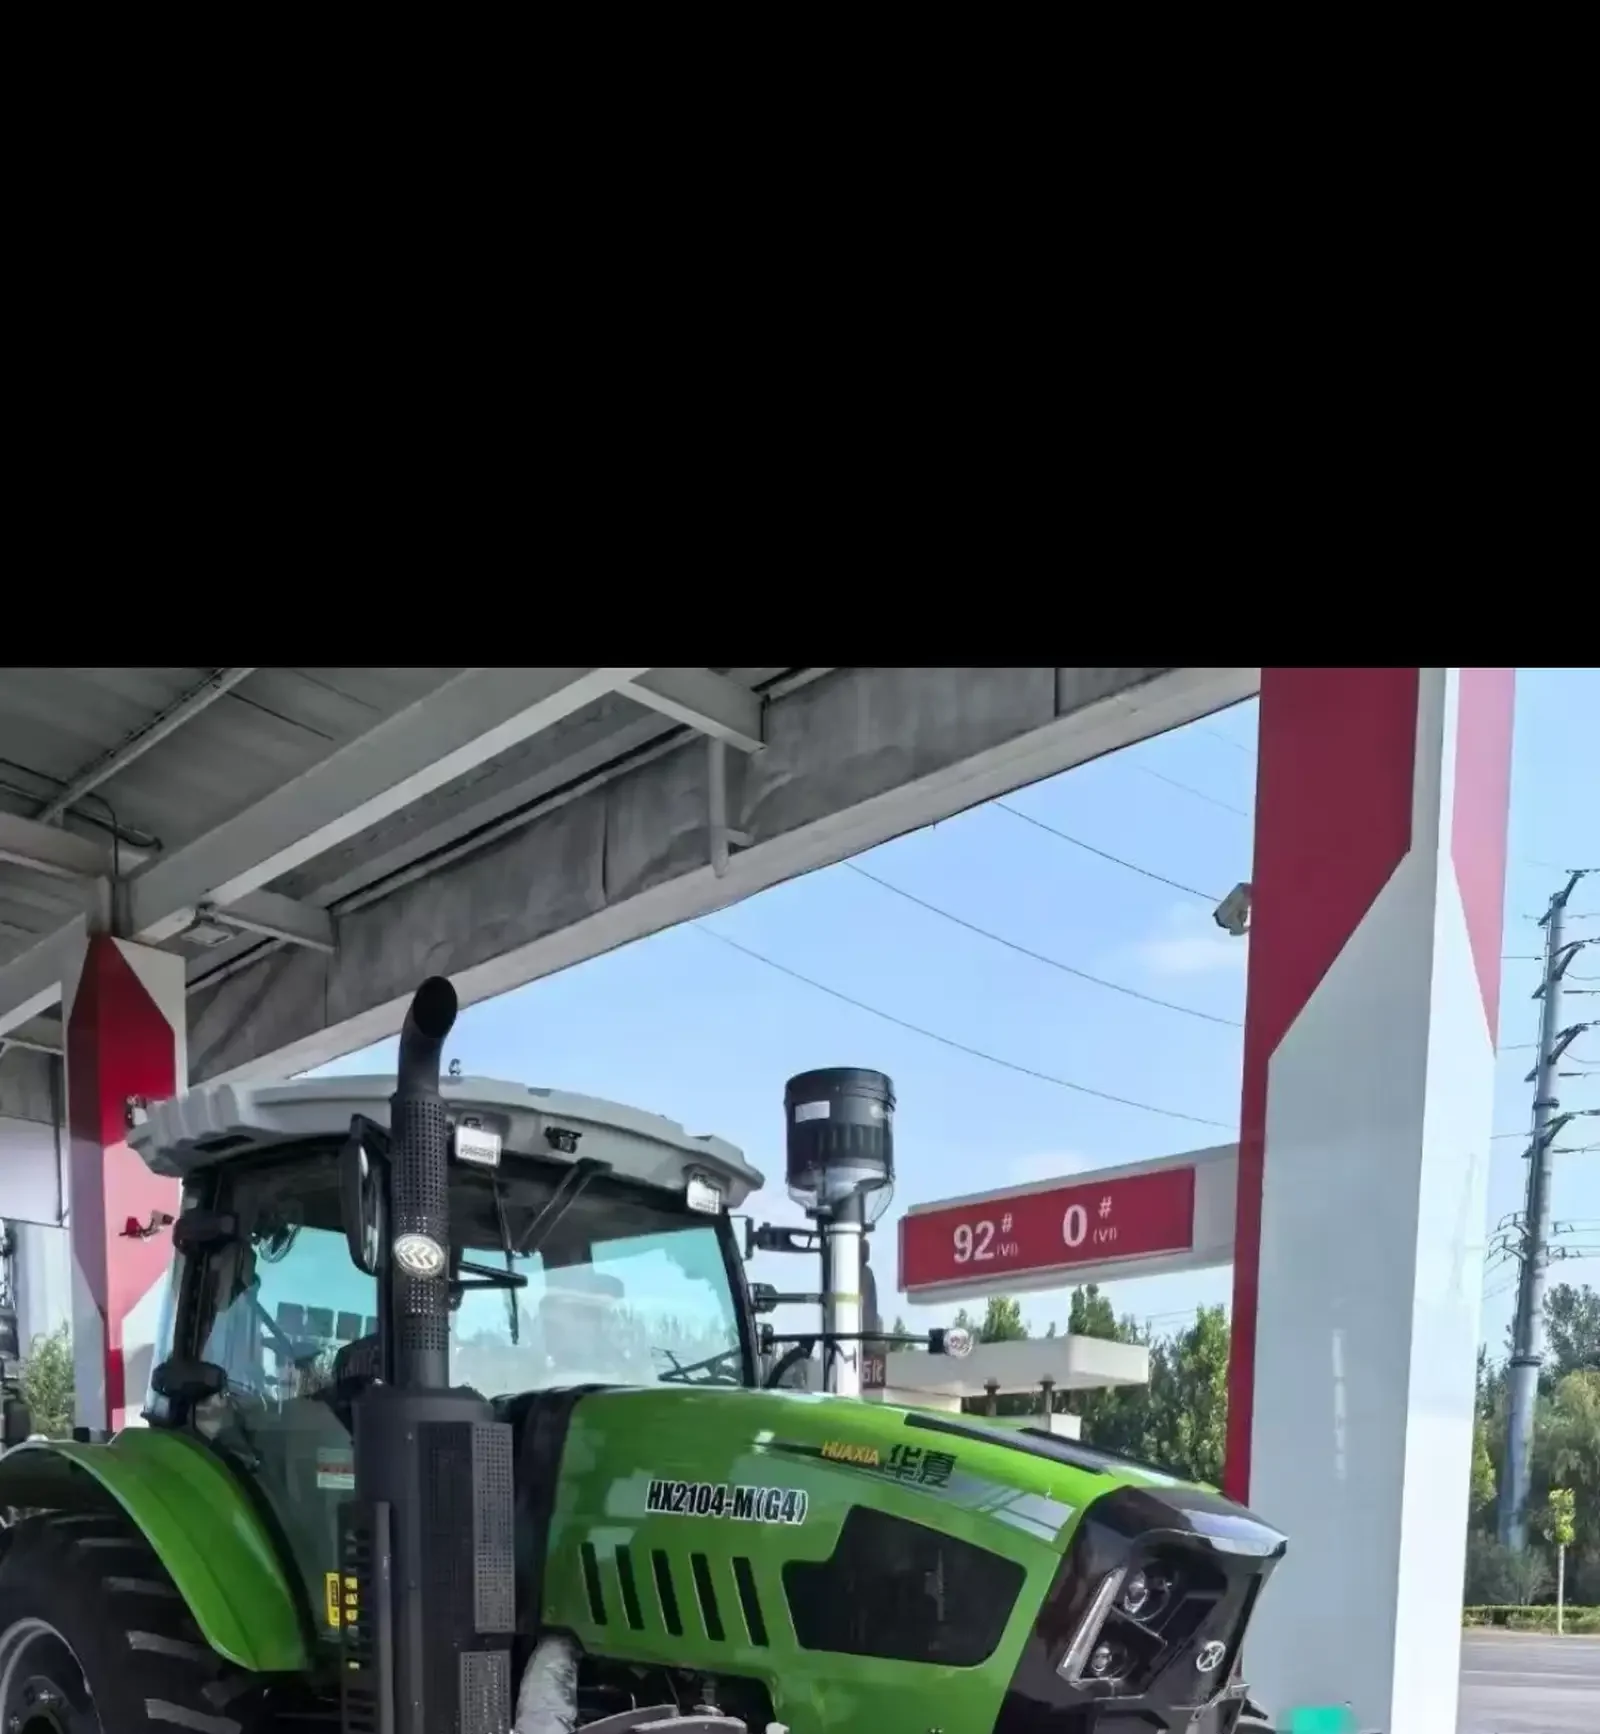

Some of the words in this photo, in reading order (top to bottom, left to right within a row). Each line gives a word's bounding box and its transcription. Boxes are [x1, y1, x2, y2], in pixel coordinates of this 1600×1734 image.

[821, 1440, 880, 1467] HUAXIA
[884, 1443, 957, 1489] 华夏
[645, 1479, 809, 1525] HX2104-M(G4)
